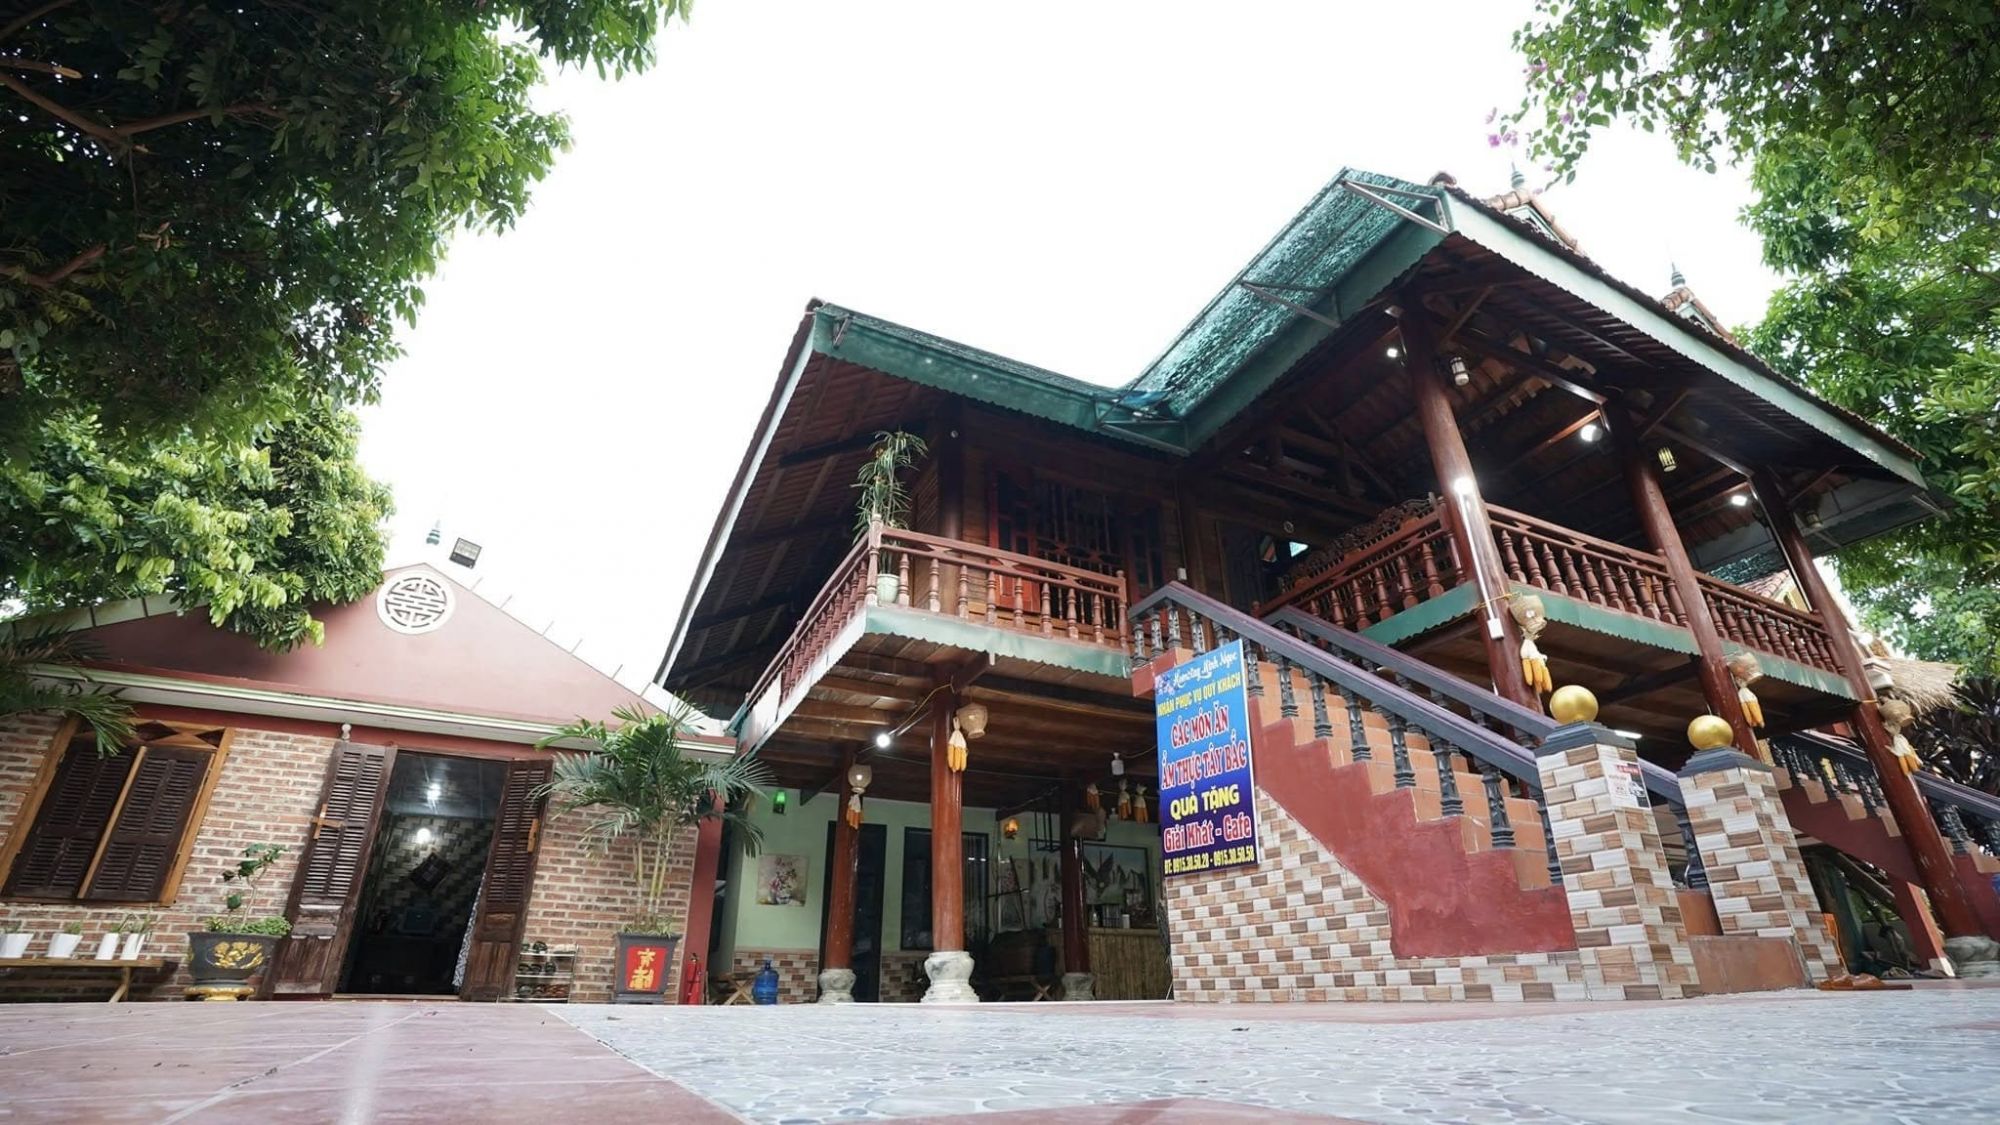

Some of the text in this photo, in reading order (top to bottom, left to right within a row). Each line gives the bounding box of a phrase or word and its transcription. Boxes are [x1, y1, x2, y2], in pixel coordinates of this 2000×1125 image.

[1175, 691, 1193, 710] PHỤC
[1193, 687, 1202, 705] VỤ
[1217, 671, 1241, 694] KHÁCH
[1171, 700, 1229, 749] CÁC MÓN ĂN
[1176, 751, 1202, 789] THỰC
[1202, 742, 1224, 779] TÂY
[1223, 728, 1247, 773] BẮC
[1170, 784, 1240, 820] QUÀ TẶNG
[1164, 824, 1186, 853] Giải
[1186, 820, 1215, 849] Khát
[1223, 811, 1252, 842] Cafe
